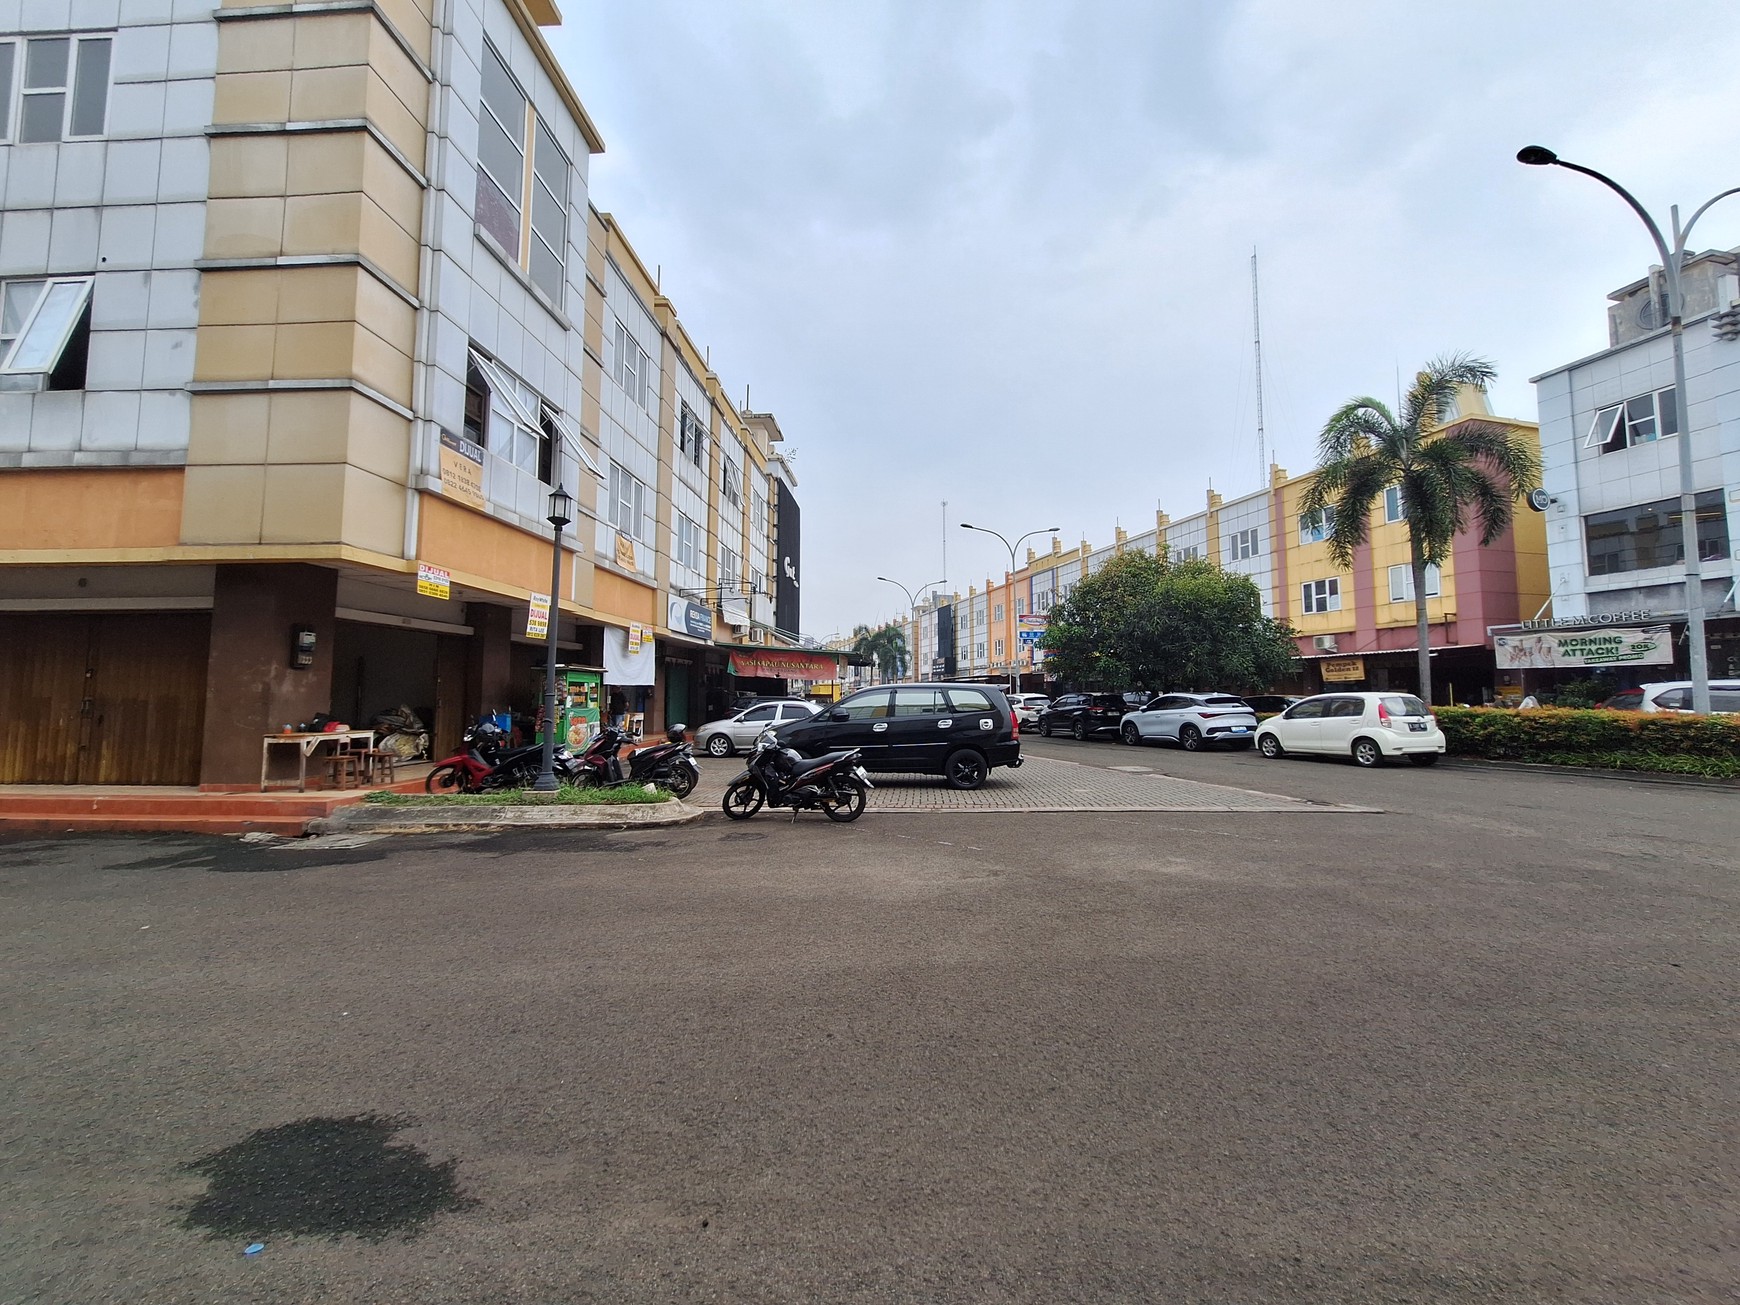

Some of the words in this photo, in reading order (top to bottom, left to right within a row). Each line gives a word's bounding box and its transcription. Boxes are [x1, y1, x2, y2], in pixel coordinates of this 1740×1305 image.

[459, 440, 482, 463] DIJUAL
[419, 564, 450, 578] DIJUAL
[530, 609, 548, 620] DIJUAL
[1521, 616, 1569, 630] LITTLE
[1588, 609, 1651, 626] COFFEE
[1557, 636, 1623, 648] MORNING
[1561, 646, 1620, 658] ATTACK!
[780, 661, 824, 670] NUSANTARA
